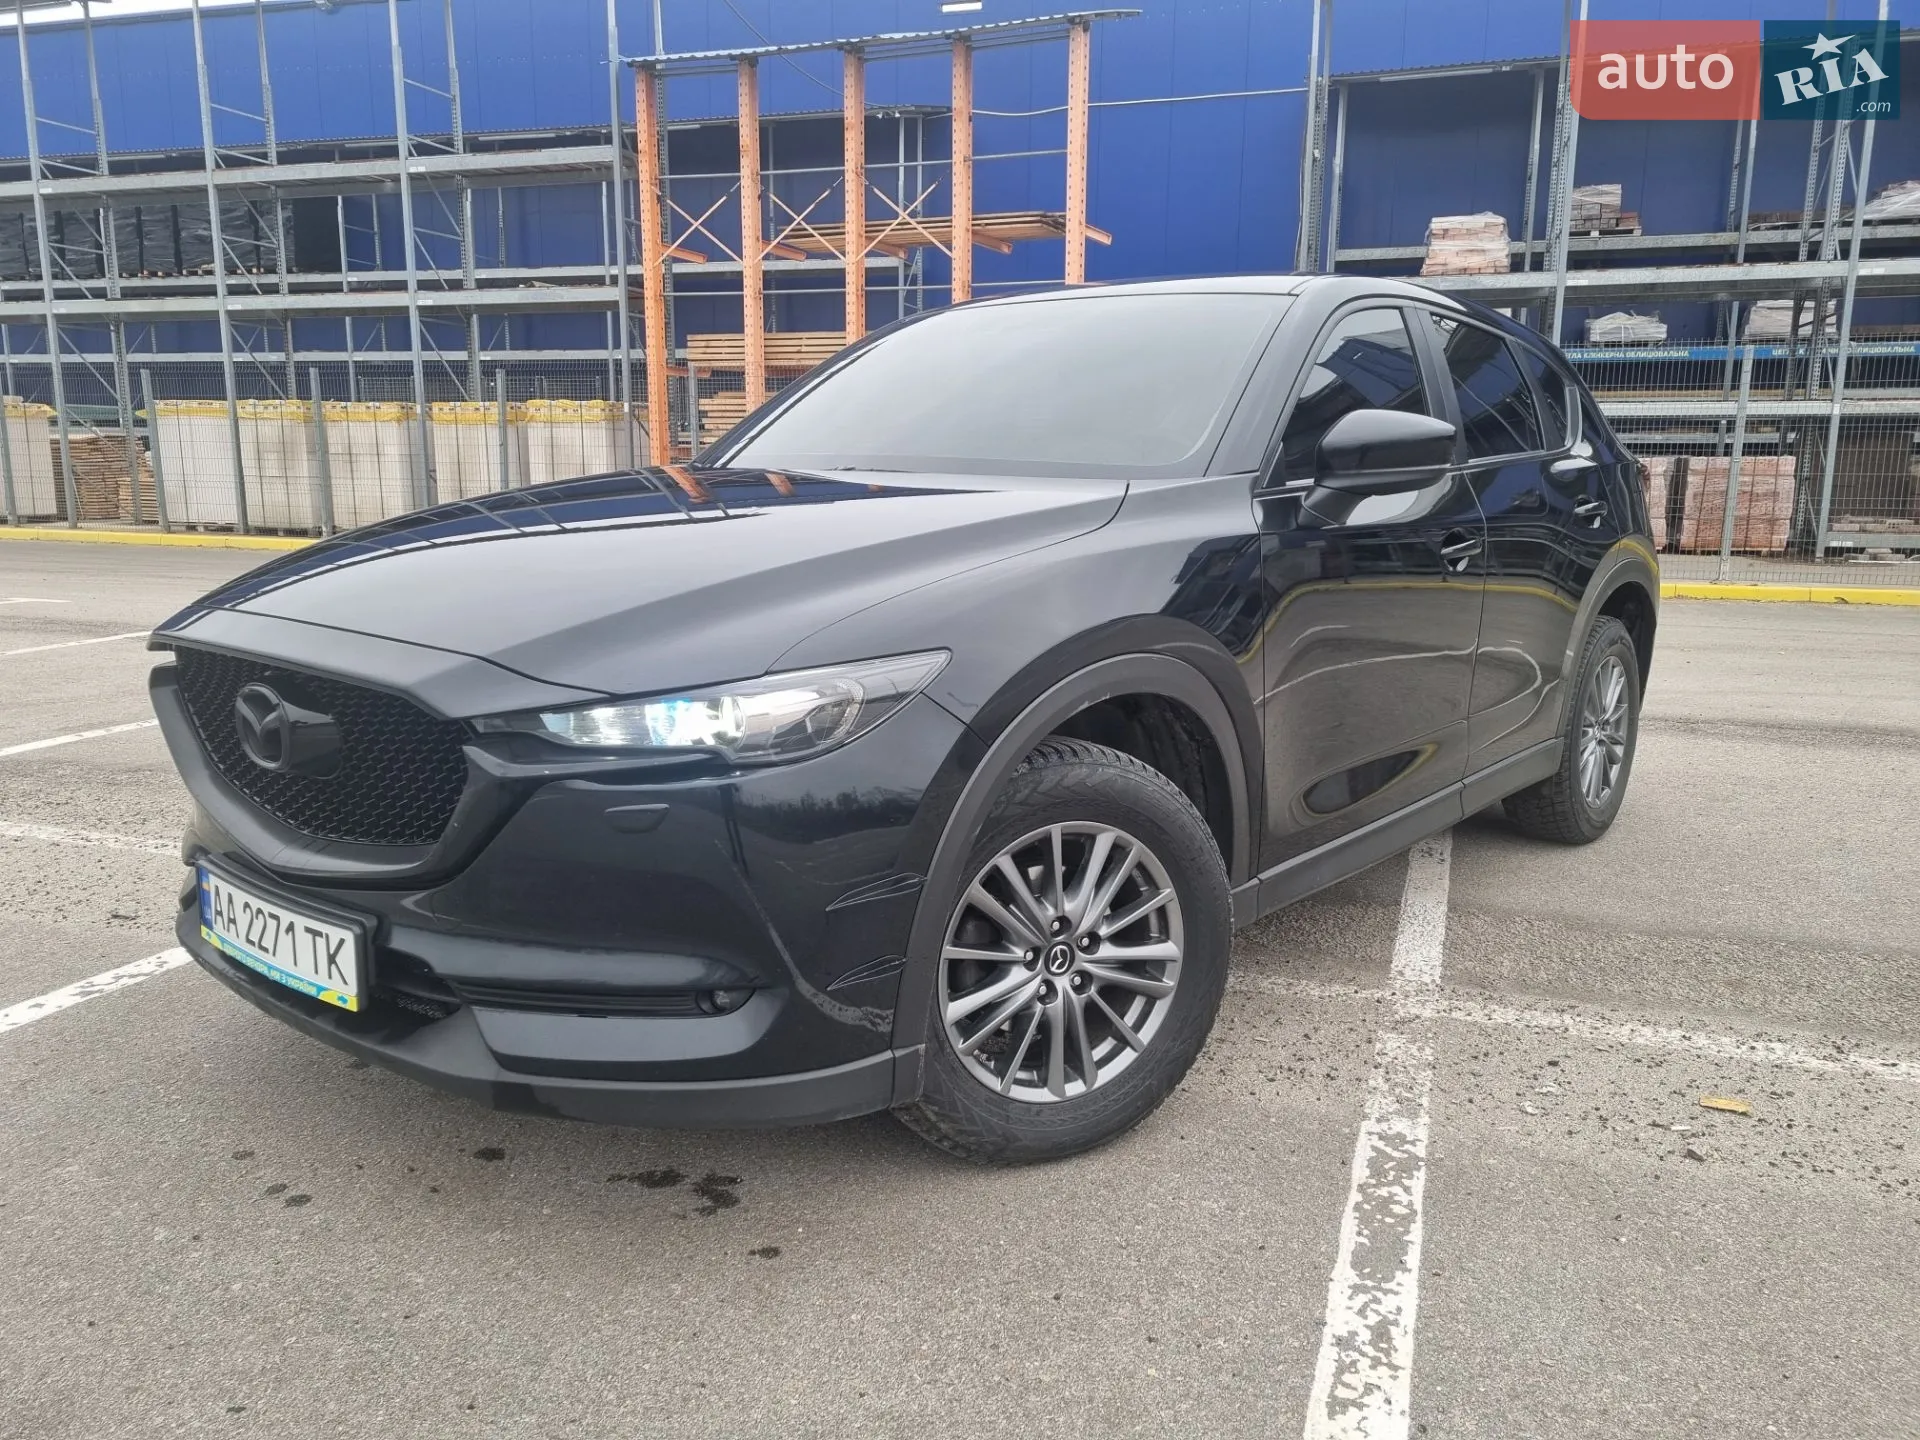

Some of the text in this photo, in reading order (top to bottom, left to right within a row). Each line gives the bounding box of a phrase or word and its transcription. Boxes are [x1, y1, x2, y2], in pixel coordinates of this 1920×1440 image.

[214, 884, 349, 986] AA 2271 TK
